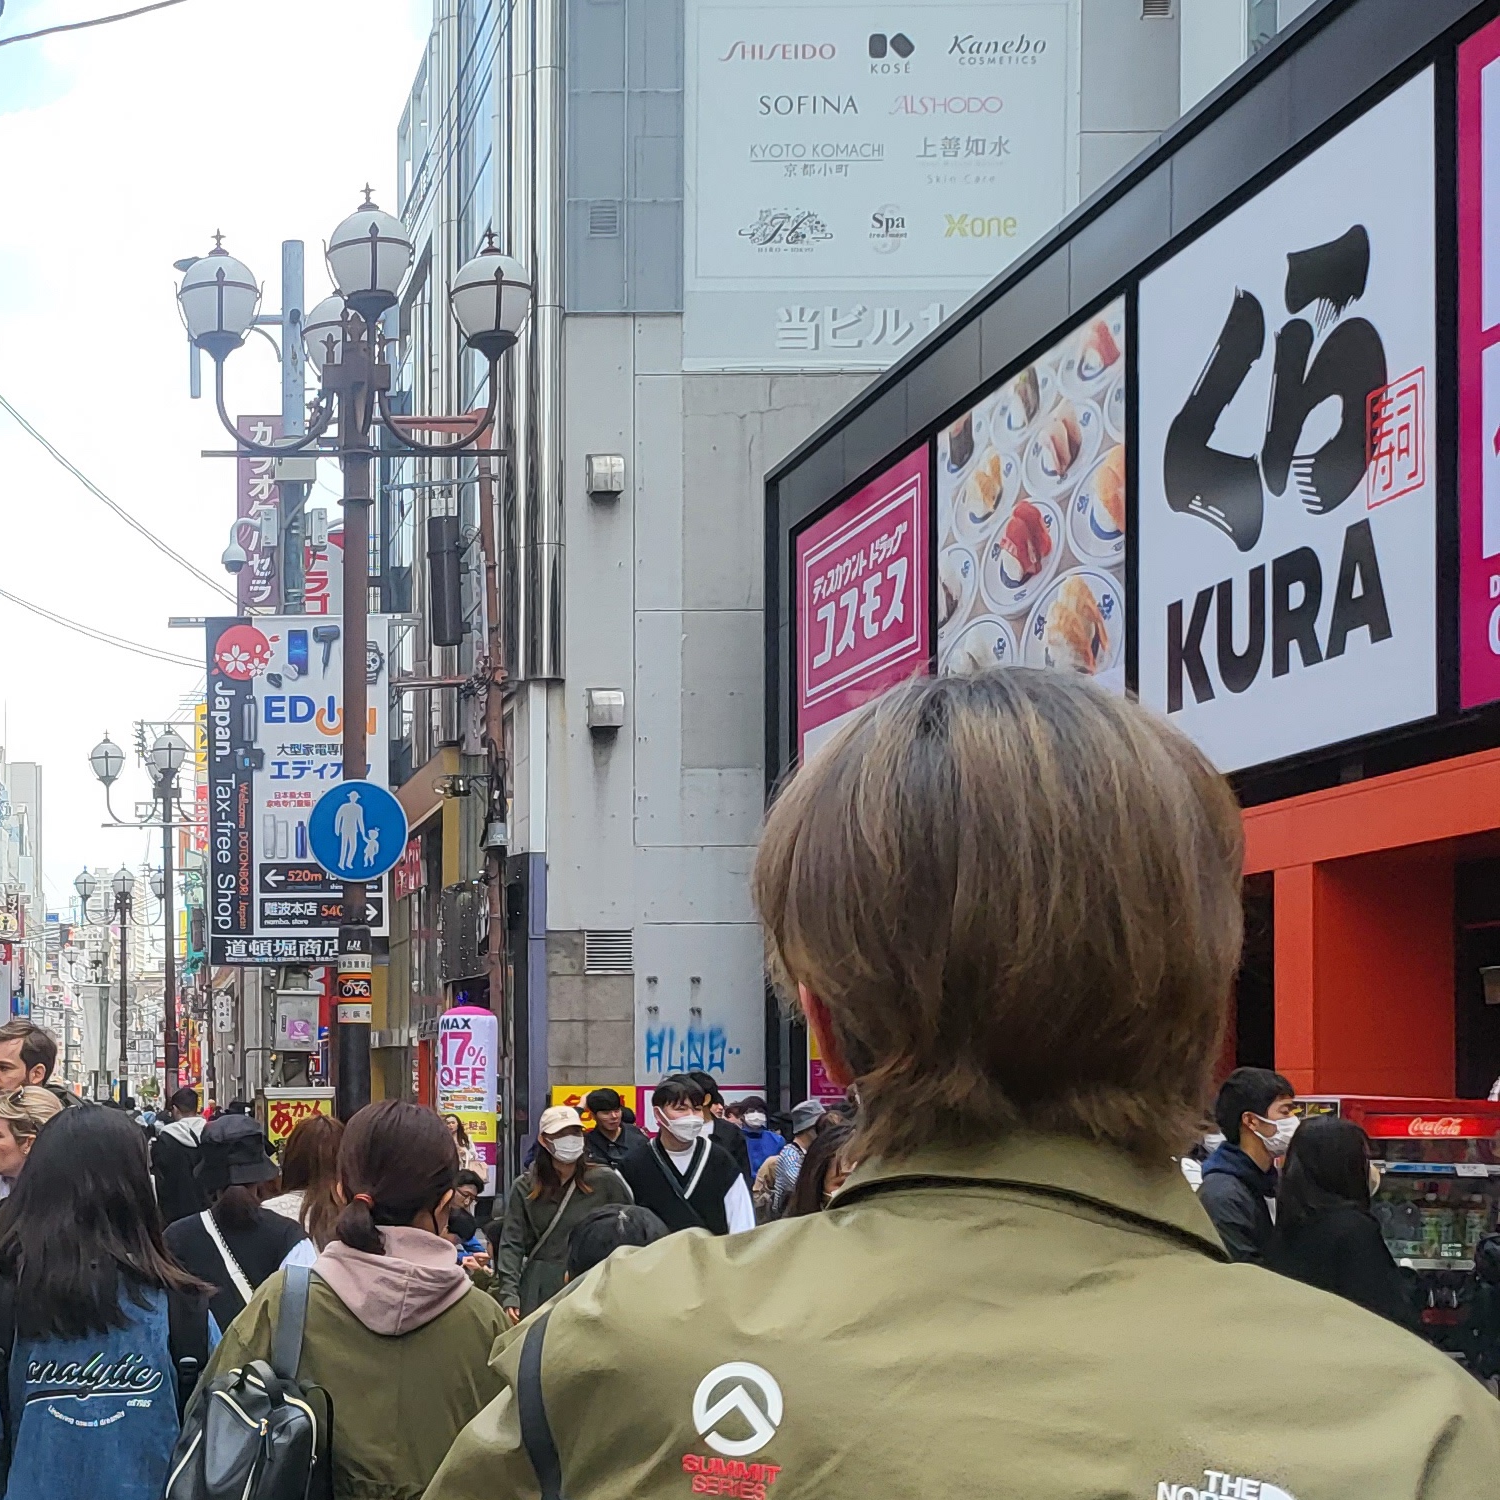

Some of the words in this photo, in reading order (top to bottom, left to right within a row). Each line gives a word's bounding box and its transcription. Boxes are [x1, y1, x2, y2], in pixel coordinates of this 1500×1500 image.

[718, 41, 836, 62] SHISEIDO
[948, 34, 1047, 55] Kanebo
[871, 61, 911, 74] KOSÉ
[958, 56, 1037, 65] COSMETICS
[759, 95, 859, 115] SOFINA
[750, 143, 806, 158] KYOTO
[812, 143, 884, 158] KOMACHI
[916, 136, 1011, 158] 上善如水
[784, 163, 849, 177] 京都小町
[871, 212, 906, 233] Spa
[1163, 224, 1389, 552] くら
[813, 549, 867, 605] ディスカウント
[813, 556, 908, 670] コスモス
[1166, 518, 1393, 714] KURA
[214, 681, 236, 763] Japan.
[214, 773, 236, 864] Tax-free
[286, 870, 323, 882] 520m
[213, 873, 236, 930] Shop
[441, 1018, 471, 1030] MAX
[440, 1032, 486, 1066] 17%
[440, 1067, 486, 1087] OFF
[682, 1454, 782, 1485] SUMMIT
[1203, 1469, 1261, 1500] THE
